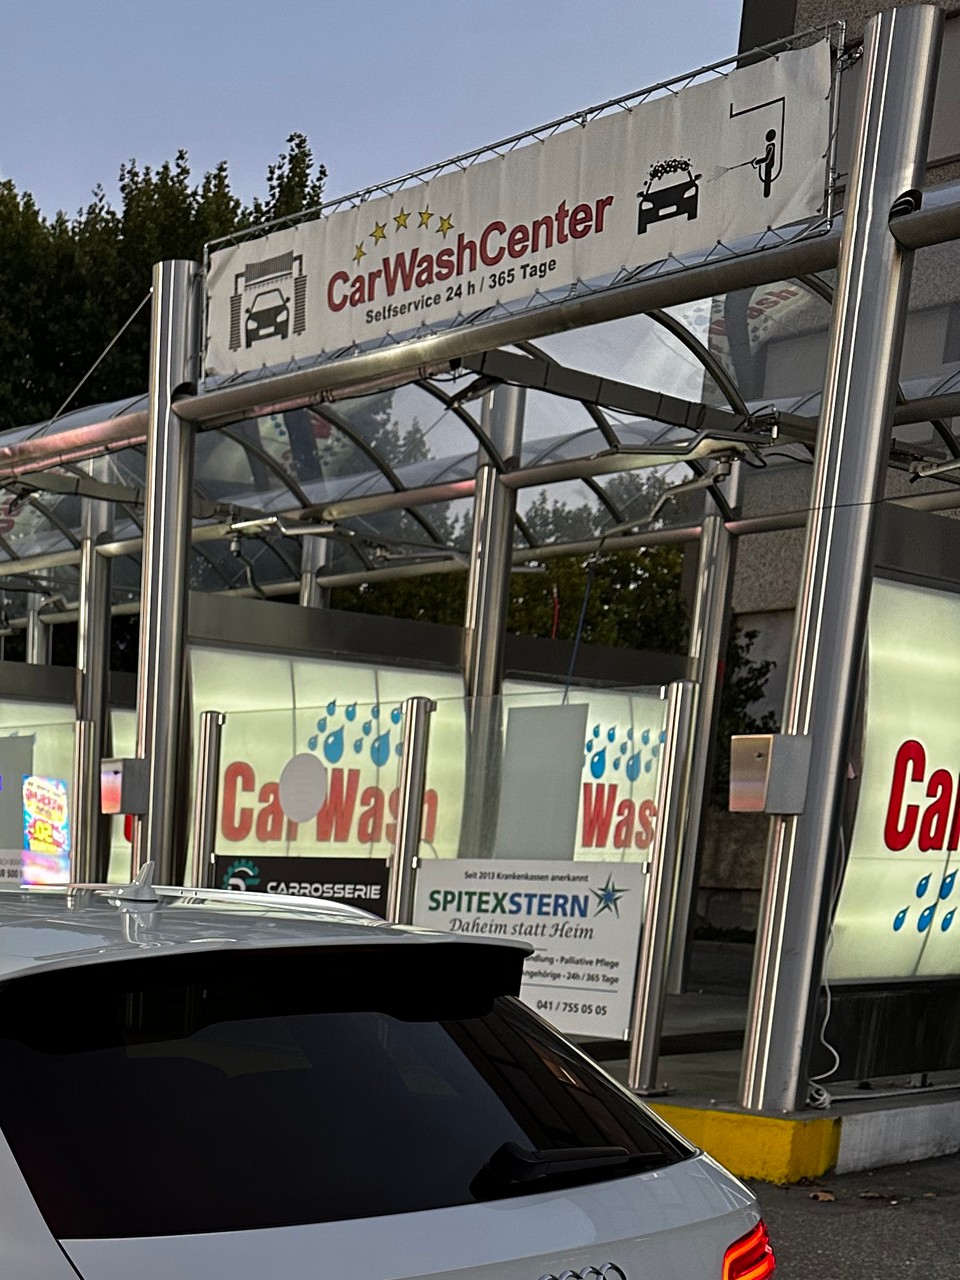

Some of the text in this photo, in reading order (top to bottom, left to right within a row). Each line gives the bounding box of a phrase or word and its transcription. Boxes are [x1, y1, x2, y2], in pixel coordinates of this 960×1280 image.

[327, 196, 614, 313] CarWashCenter
[365, 291, 441, 325] Selfservice
[445, 283, 463, 302] 24
[468, 281, 476, 295] h
[488, 268, 516, 289] 365
[520, 258, 557, 279] Tage
[581, 782, 657, 850] Was
[464, 871, 589, 882] Seit 2013 Krankenkassen anerkannt
[266, 881, 382, 899] CARROSSERIE
[428, 889, 589, 918] SPITEXSTERN
[449, 917, 594, 939] Daheim statt Heim
[560, 955, 594, 967] Palliative
[595, 957, 620, 970] Pflege
[566, 971, 580, 981] 24h
[586, 973, 600, 982] 365
[601, 974, 620, 986] Tage
[536, 1000, 553, 1010] 041
[562, 1001, 579, 1013] 755
[581, 1003, 593, 1014] 05
[595, 1005, 607, 1016] 05
